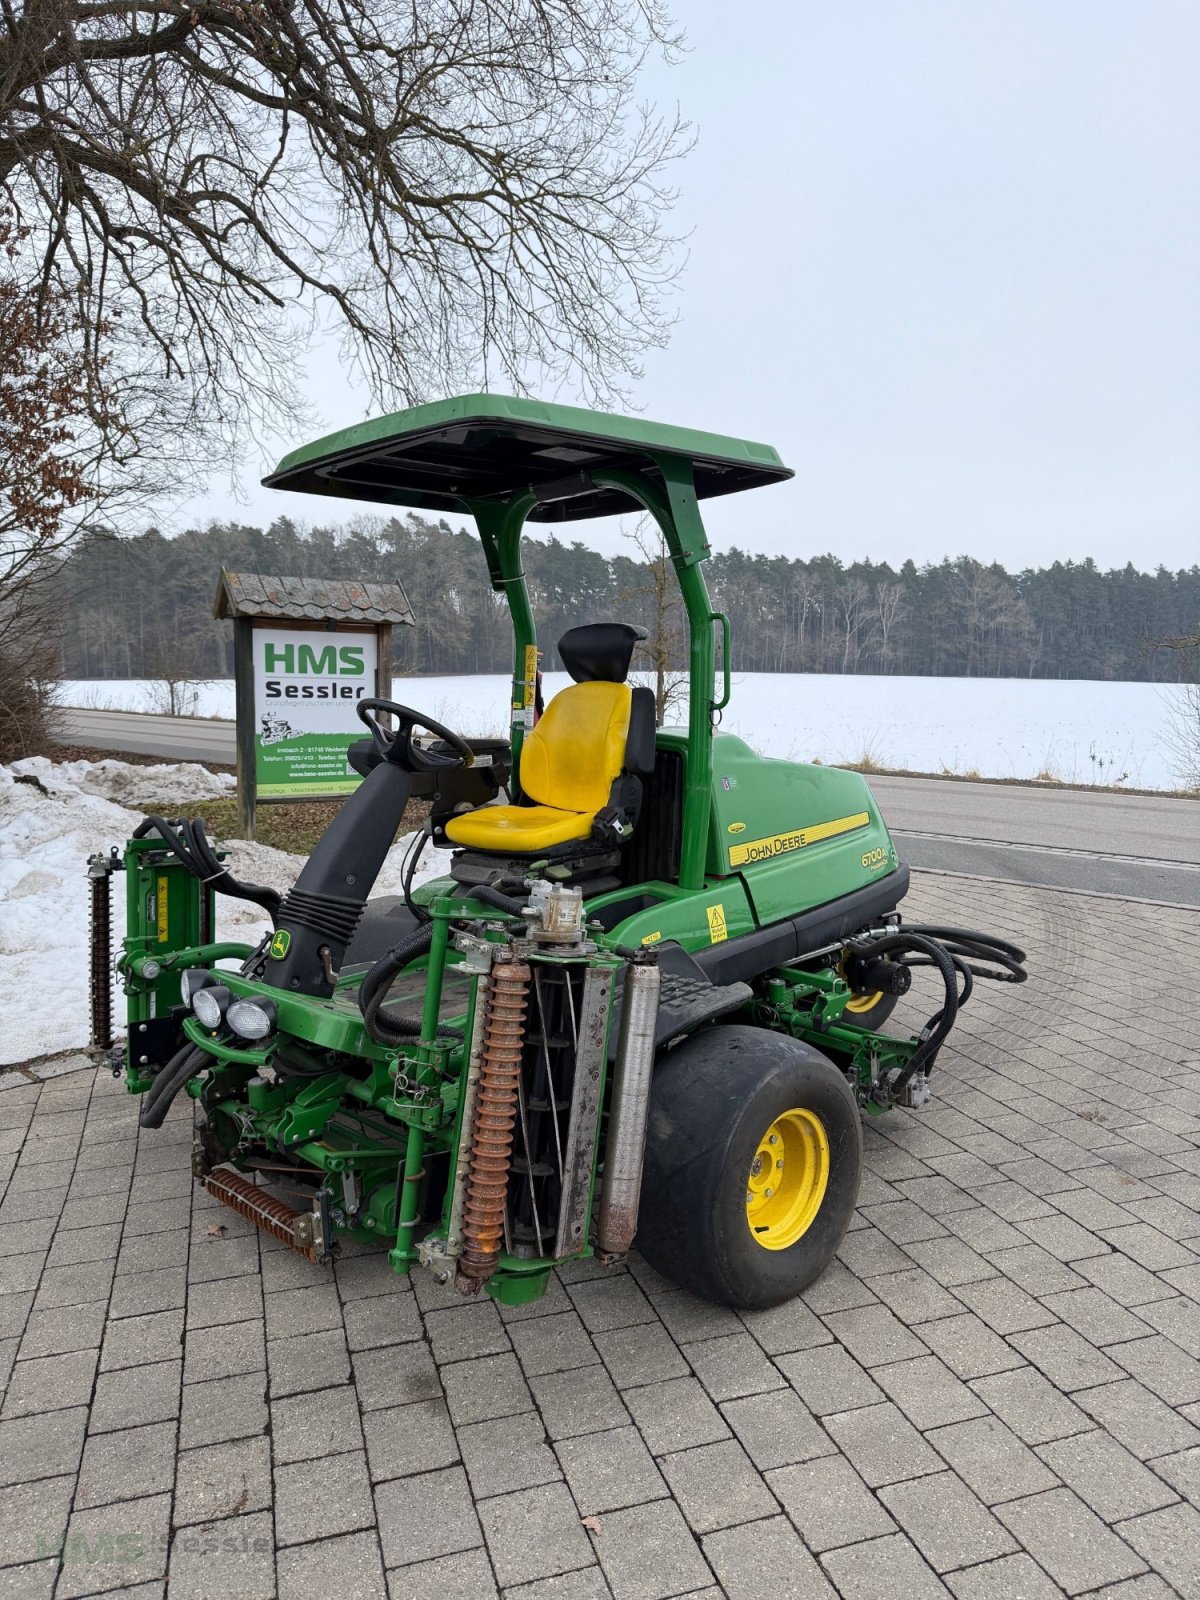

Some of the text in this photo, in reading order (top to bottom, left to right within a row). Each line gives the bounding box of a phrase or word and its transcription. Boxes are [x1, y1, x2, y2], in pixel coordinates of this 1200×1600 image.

[264, 643, 365, 675] HMS
[265, 681, 365, 699] Sessler
[744, 834, 807, 863] JOHN DEERE
[861, 847, 888, 867] 6700A
